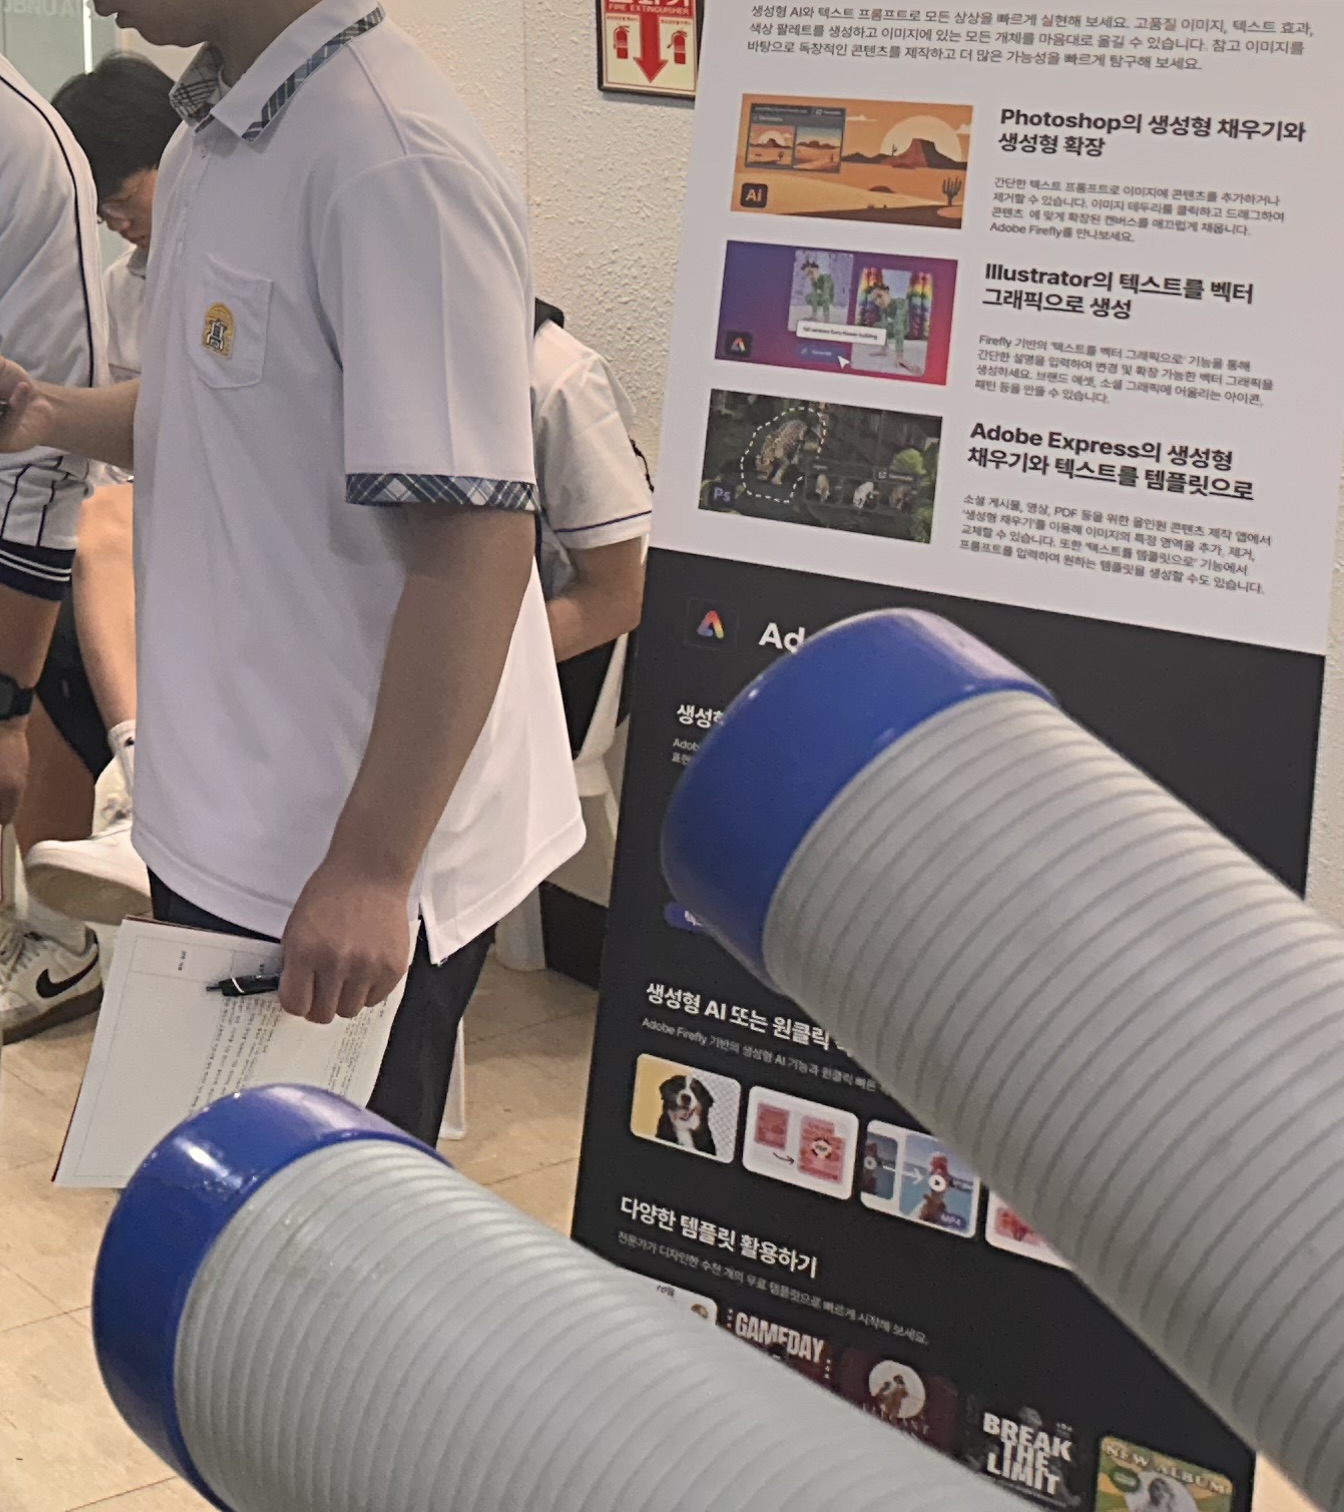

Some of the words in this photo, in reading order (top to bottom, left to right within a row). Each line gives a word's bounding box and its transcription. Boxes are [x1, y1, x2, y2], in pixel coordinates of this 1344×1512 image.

[608, 3, 627, 12] FIRE
[630, 4, 690, 16] EXTINGUISHER
[751, 4, 787, 18] 생성형
[789, 6, 814, 18] AI와
[817, 6, 854, 19] 텍스트
[858, 8, 921, 22] 프롬프트로
[924, 10, 950, 24] 모든
[954, 11, 993, 25] 상상을
[996, 13, 1037, 26] 빠르게
[1041, 14, 1082, 28] 실현해
[1085, 16, 1129, 28] 보세요.
[1134, 17, 1177, 31] 고품질
[1180, 18, 1227, 34] 이미지,
[1232, 20, 1276, 33] 텍스트
[1280, 21, 1313, 37] 효과,
[747, 40, 795, 53] 바탕으로
[798, 41, 848, 56] 독창적인
[851, 44, 901, 58] 콘텐츠를
[904, 46, 956, 60] 제작하고
[959, 48, 973, 61] 더
[976, 49, 1002, 63] 많은
[1006, 50, 1060, 65] 가능성을
[1063, 53, 1106, 66] 빠르게
[1109, 54, 1152, 68] 탐구해
[1155, 57, 1201, 70] 보세요.
[749, 22, 773, 36] 색상
[776, 23, 825, 37] 팔레트를
[828, 25, 877, 38] 생성하고
[880, 27, 932, 41] 이미지에
[935, 29, 961, 43] 있는
[964, 30, 991, 44] 모든
[995, 31, 1035, 45] 개체를
[1038, 32, 1093, 46] 마음대로
[1129, 36, 1142, 49] 수
[1146, 36, 1207, 51] 있습니다.
[1212, 38, 1240, 53] 참고
[1245, 40, 1304, 55] 이미지를
[1000, 108, 1143, 134] Photoshop의
[1148, 115, 1212, 137] 생성형
[1217, 118, 1306, 142] 채우기와
[998, 132, 1058, 154] 생성형
[1063, 135, 1105, 157] 확장
[745, 188, 762, 202] Ai
[985, 263, 1113, 291] Illustrator의
[1118, 273, 1204, 300] 텍스트를
[1210, 281, 1254, 304] 벡터
[982, 288, 1084, 313] 그래픽으로
[1090, 297, 1132, 320] 생성
[970, 422, 1043, 446] Adobe
[1047, 431, 1162, 462] Express의
[1167, 445, 1233, 471] 생성형
[967, 447, 1049, 475] 채우기와
[1054, 458, 1138, 487] 텍스트를
[1144, 469, 1253, 500] 템플릿으로
[714, 487, 732, 502] Ps
[646, 983, 701, 1014] 생성형
[704, 1000, 727, 1020] AI
[729, 1005, 768, 1033] 또는
[772, 1017, 830, 1050] 원클릭
[620, 1197, 676, 1231] 다양한
[680, 1215, 736, 1251] 템플릿
[740, 1234, 817, 1277] 활용하기
[982, 1412, 1073, 1463] BREAK
[1002, 1438, 1050, 1474] THE
[1104, 1443, 1149, 1468] NEW
[986, 1451, 1060, 1496] LIMIT
